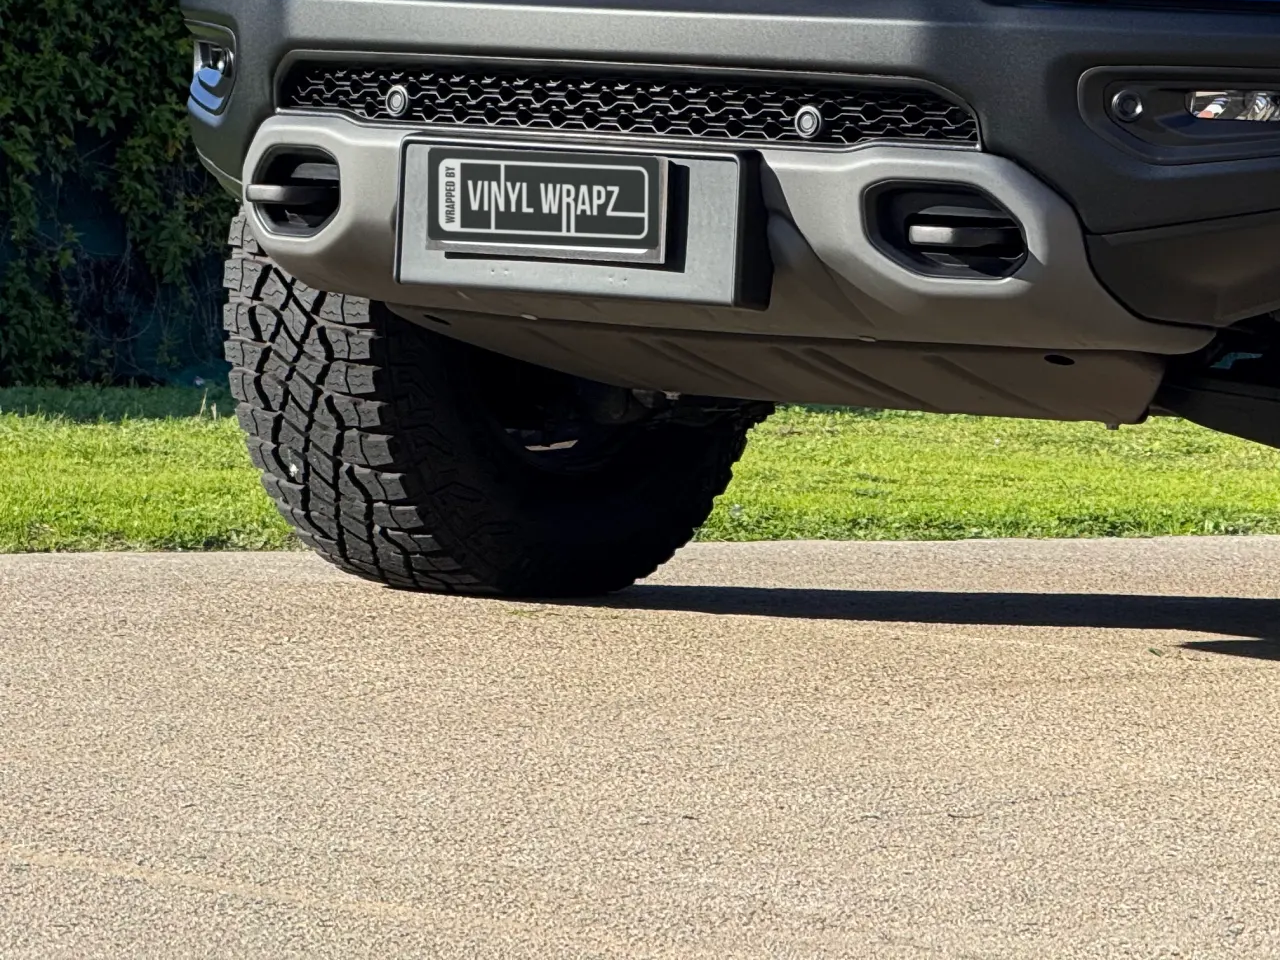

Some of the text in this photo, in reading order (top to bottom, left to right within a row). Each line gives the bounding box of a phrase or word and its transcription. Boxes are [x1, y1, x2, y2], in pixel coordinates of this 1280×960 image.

[445, 166, 456, 224] WRAPPED BY
[467, 178, 620, 218] VINYL WRAPZ
